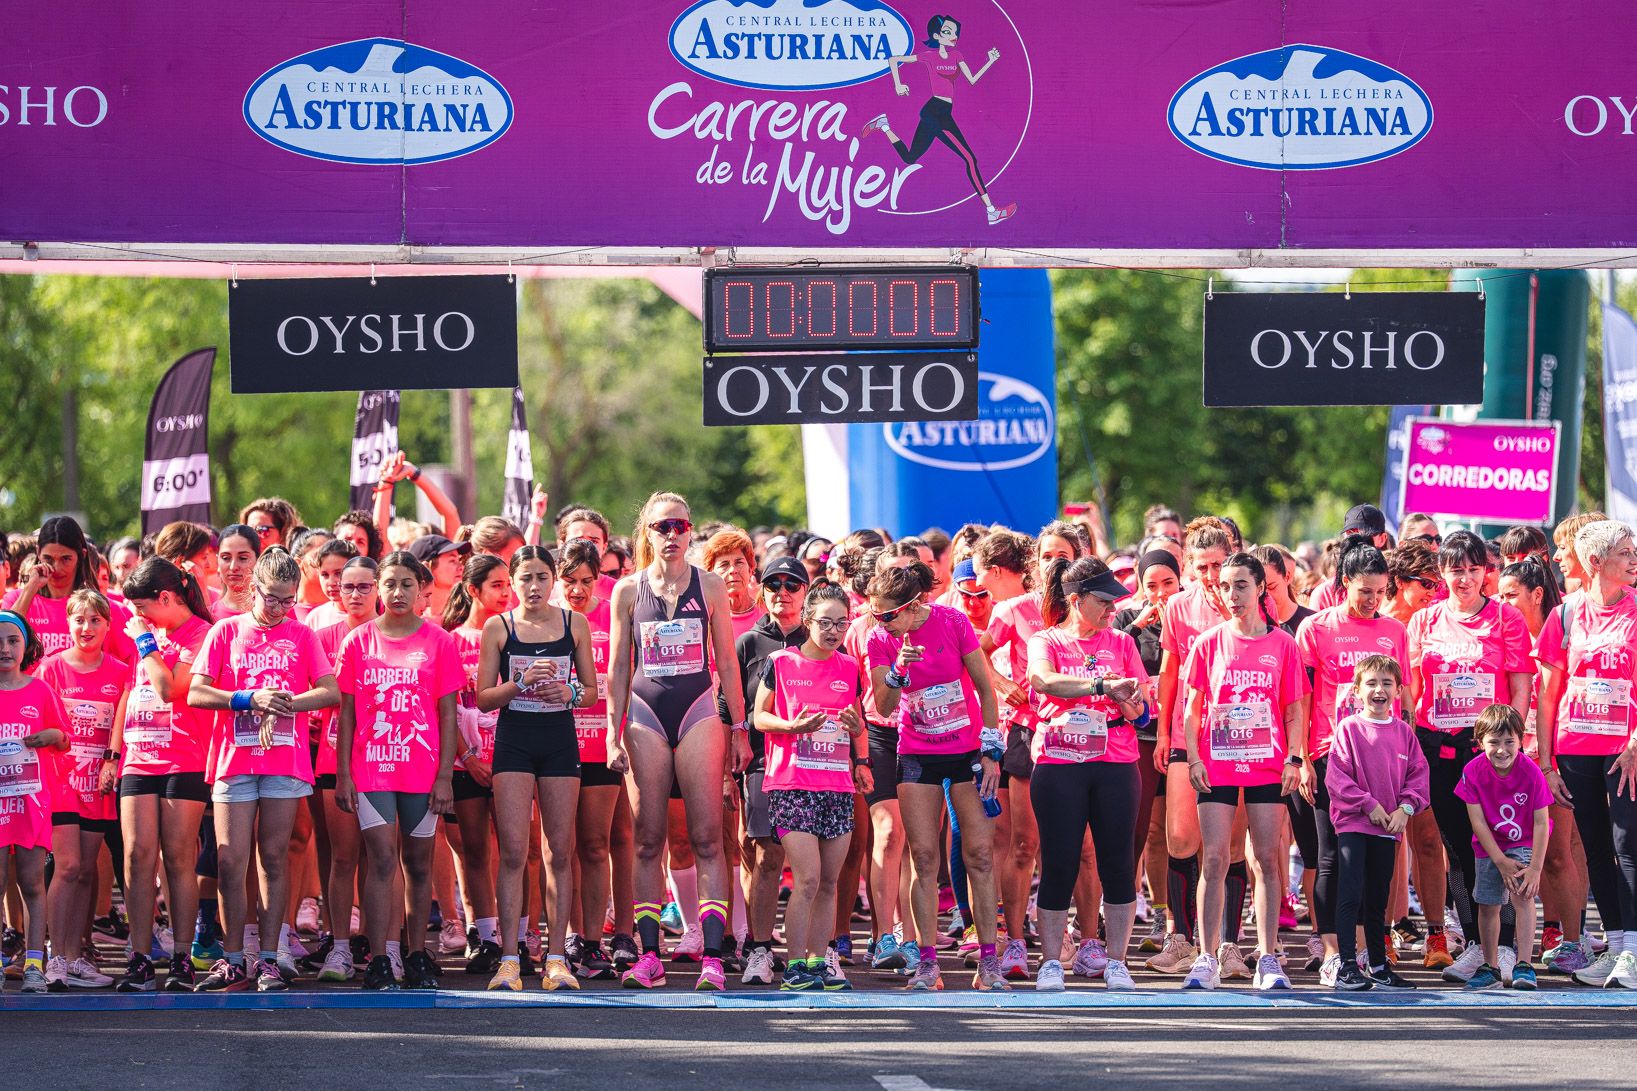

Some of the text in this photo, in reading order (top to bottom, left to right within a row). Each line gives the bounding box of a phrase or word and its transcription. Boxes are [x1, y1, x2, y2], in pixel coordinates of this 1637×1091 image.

[726, 15, 887, 28] CENTRAL LECHERA
[688, 17, 894, 61] ASTURIANA
[306, 81, 484, 96] CENTRAL LECHERA
[1230, 88, 1403, 100] CENTRAL LECHERA
[264, 84, 493, 133] ASTURIANA
[647, 82, 847, 142] Carrera
[1188, 91, 1412, 137] ASTURIANA
[696, 137, 923, 235] de la Mujer
[276, 311, 476, 356] OYSHO
[1249, 329, 1445, 370] OYSHO
[717, 362, 965, 416] OYSHO
[156, 414, 203, 433] OYSHO
[1493, 435, 1551, 453] OYSHO
[1408, 462, 1549, 492] CORREDORAS
[661, 645, 685, 657] 016
[235, 652, 289, 670] CARRERA
[364, 667, 419, 686] CARRERA
[786, 679, 813, 687] OYSHO
[391, 689, 410, 712] DE
[1452, 697, 1475, 708] 016
[1587, 703, 1610, 714] 016
[134, 711, 154, 721] 016
[926, 704, 950, 719] 016
[73, 725, 95, 737] 016
[1063, 733, 1088, 744] 016
[1230, 728, 1254, 739] 016
[366, 742, 411, 763] MUJER
[812, 741, 836, 753] 016
[0, 764, 24, 776] 016
[378, 763, 396, 773] 2026
[1235, 762, 1251, 774] 2026
[68, 774, 99, 793] MUJE
